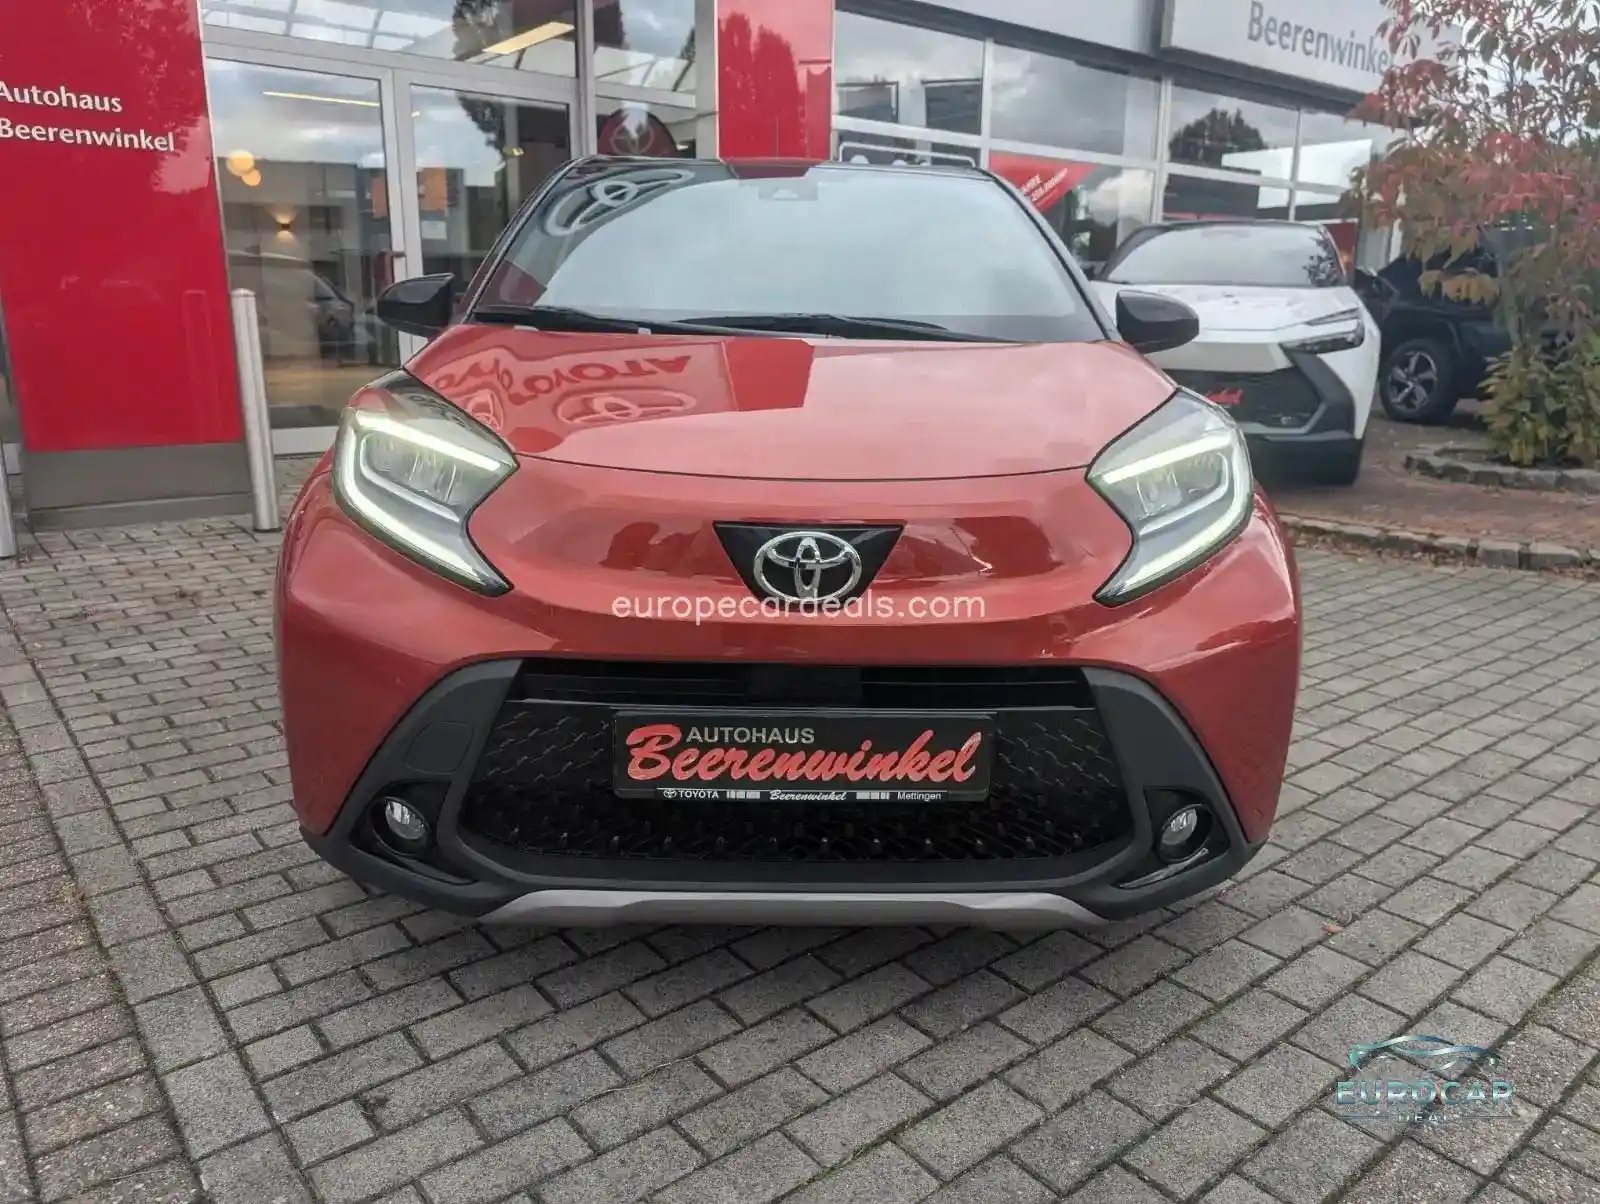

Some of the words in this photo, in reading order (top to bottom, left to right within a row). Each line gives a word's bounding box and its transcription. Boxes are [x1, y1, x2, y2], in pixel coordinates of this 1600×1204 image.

[0, 81, 123, 113] Autohaus
[0, 117, 175, 152] Beerenwinkel
[685, 726, 816, 745] AUTOHAUS
[625, 723, 983, 784] Beerenwinkel
[677, 789, 720, 800] TOYOTA
[769, 788, 848, 802] Beerenwinkel
[896, 791, 942, 802] Mettingen
